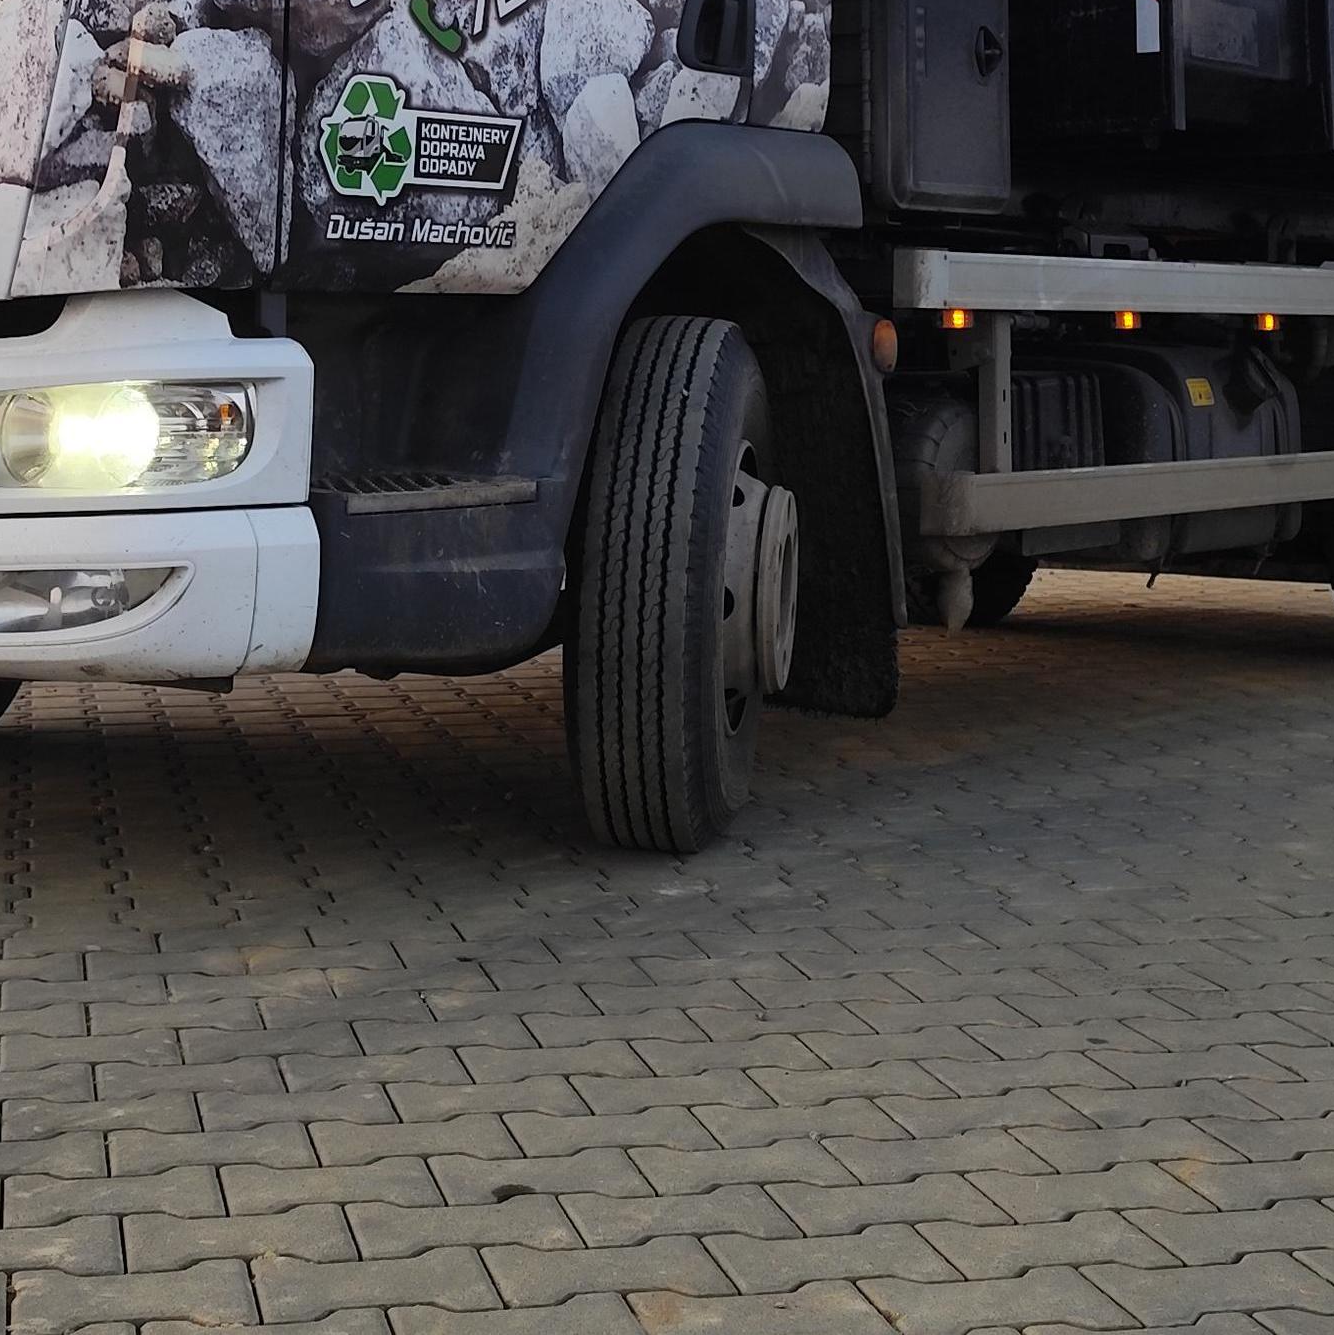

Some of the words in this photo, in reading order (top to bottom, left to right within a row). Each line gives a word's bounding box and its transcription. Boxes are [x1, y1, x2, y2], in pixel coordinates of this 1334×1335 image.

[421, 122, 509, 145] KONTEJNERY
[420, 140, 485, 160] DOPRAVA
[419, 158, 476, 177] ODPADY
